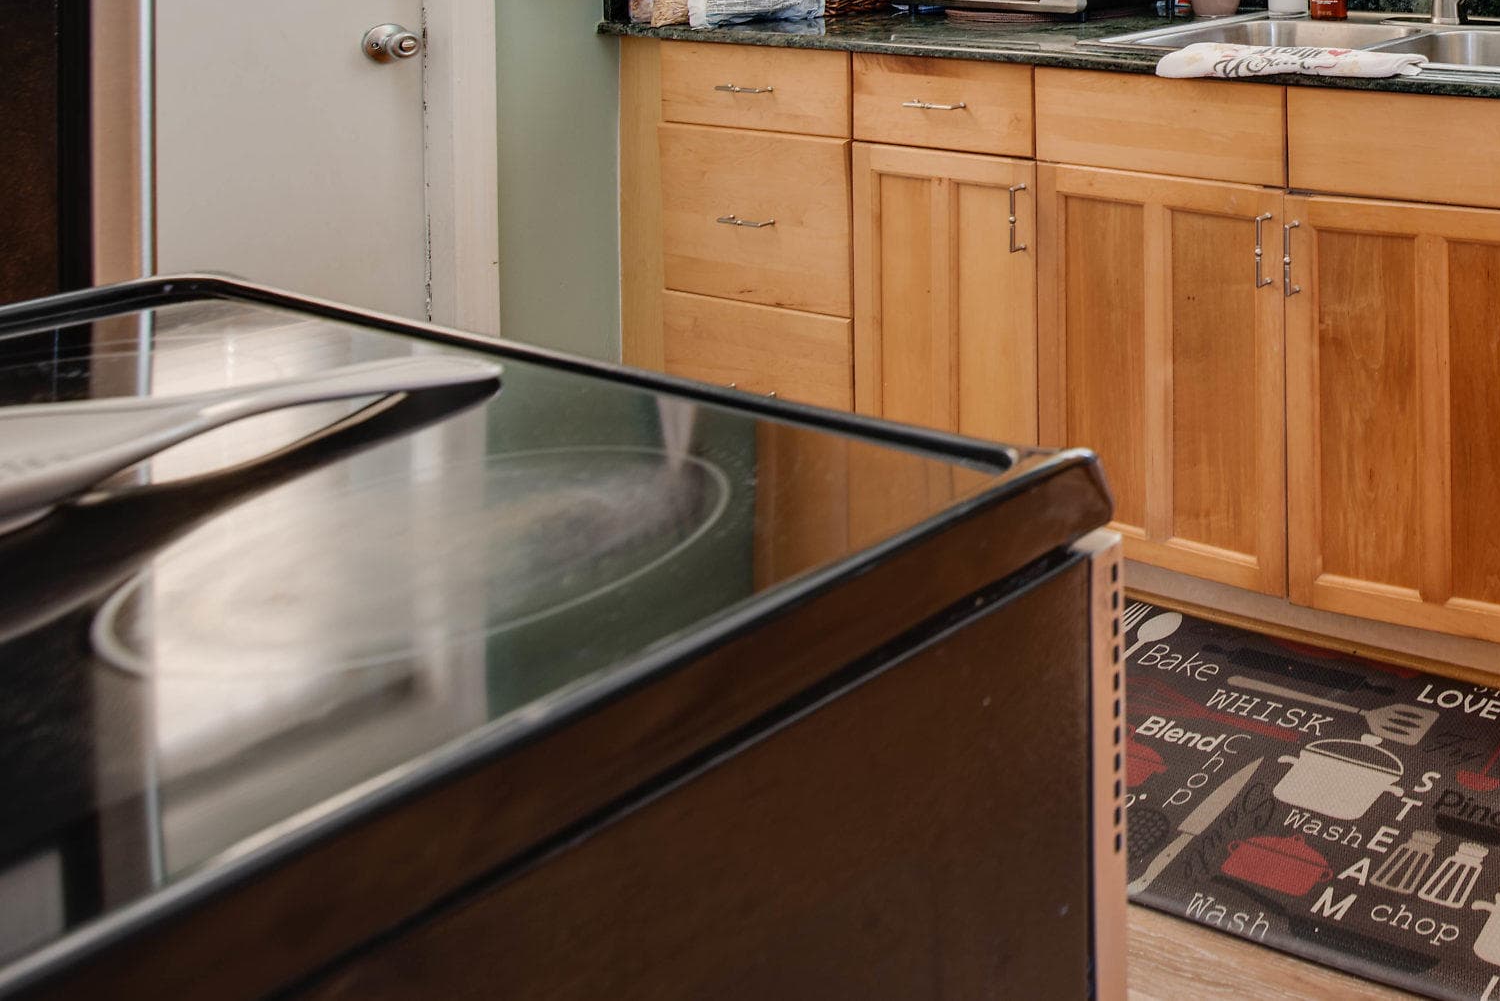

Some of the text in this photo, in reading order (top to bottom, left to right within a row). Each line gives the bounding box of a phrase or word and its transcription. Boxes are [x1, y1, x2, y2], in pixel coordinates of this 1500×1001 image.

[1137, 644, 1220, 682] Bake
[1206, 689, 1334, 736] WHISK
[1135, 715, 1227, 752] Blend
[1283, 809, 1362, 849] Wash
[1185, 892, 1270, 939] Wash
[1371, 904, 1460, 946] chop
